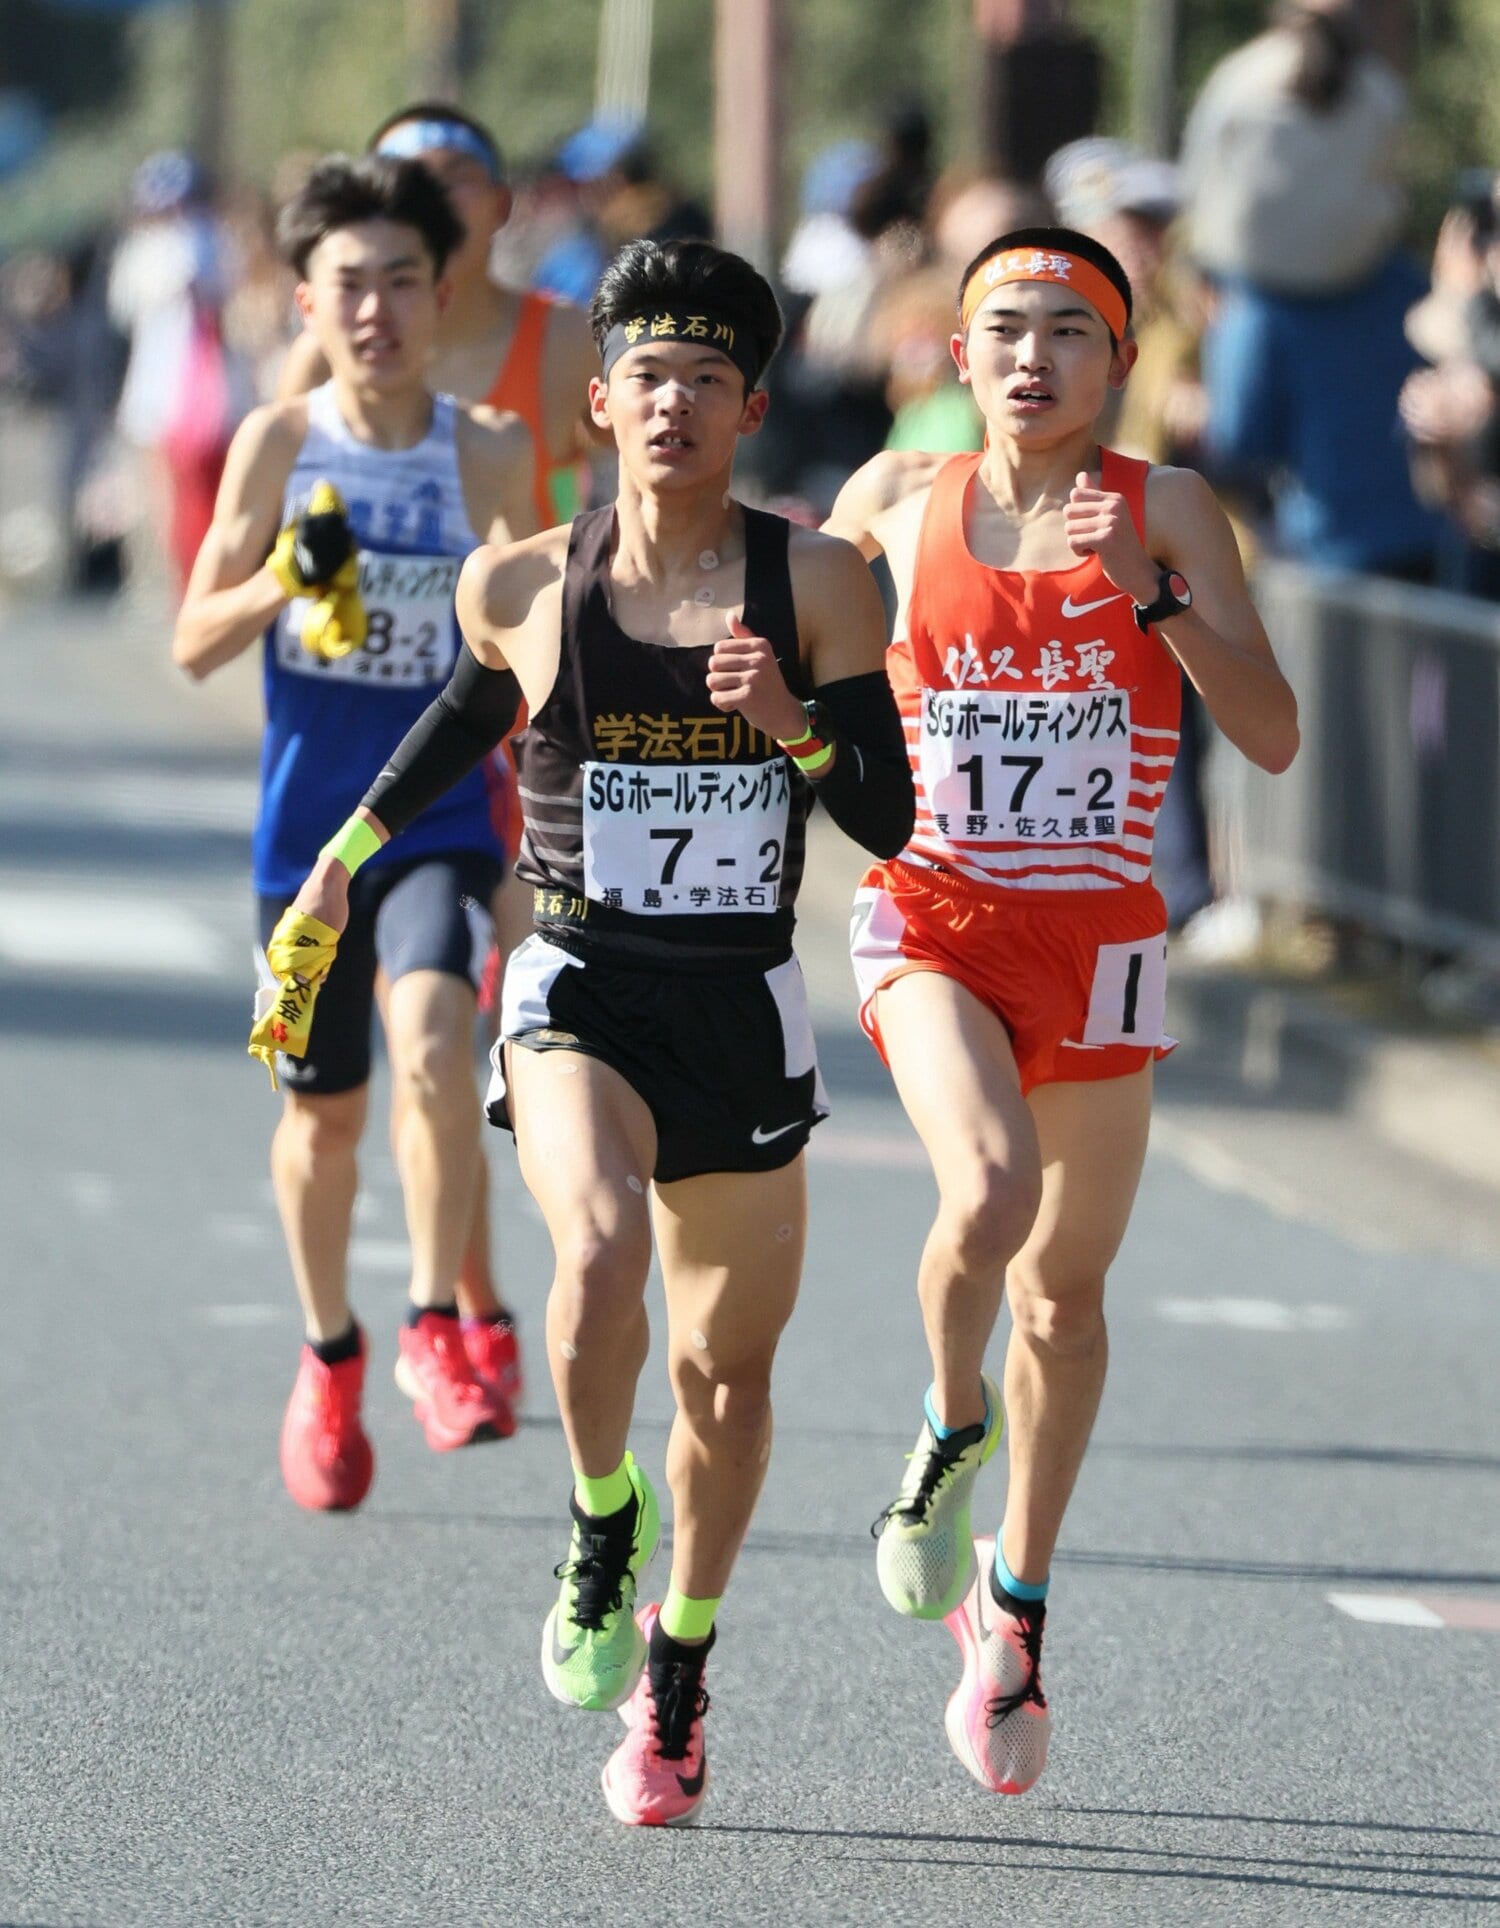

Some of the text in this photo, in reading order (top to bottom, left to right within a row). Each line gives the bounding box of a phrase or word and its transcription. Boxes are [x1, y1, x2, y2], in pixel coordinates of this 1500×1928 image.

[624, 312, 735, 350] 学法石川
[942, 633, 1116, 690] 佐久長聖
[593, 712, 772, 762] 学法石川
[926, 695, 1128, 744] SGホールディングス
[589, 761, 788, 815] SGホールディングス
[956, 754, 1116, 813] 17-2
[649, 828, 781, 885] 7-2
